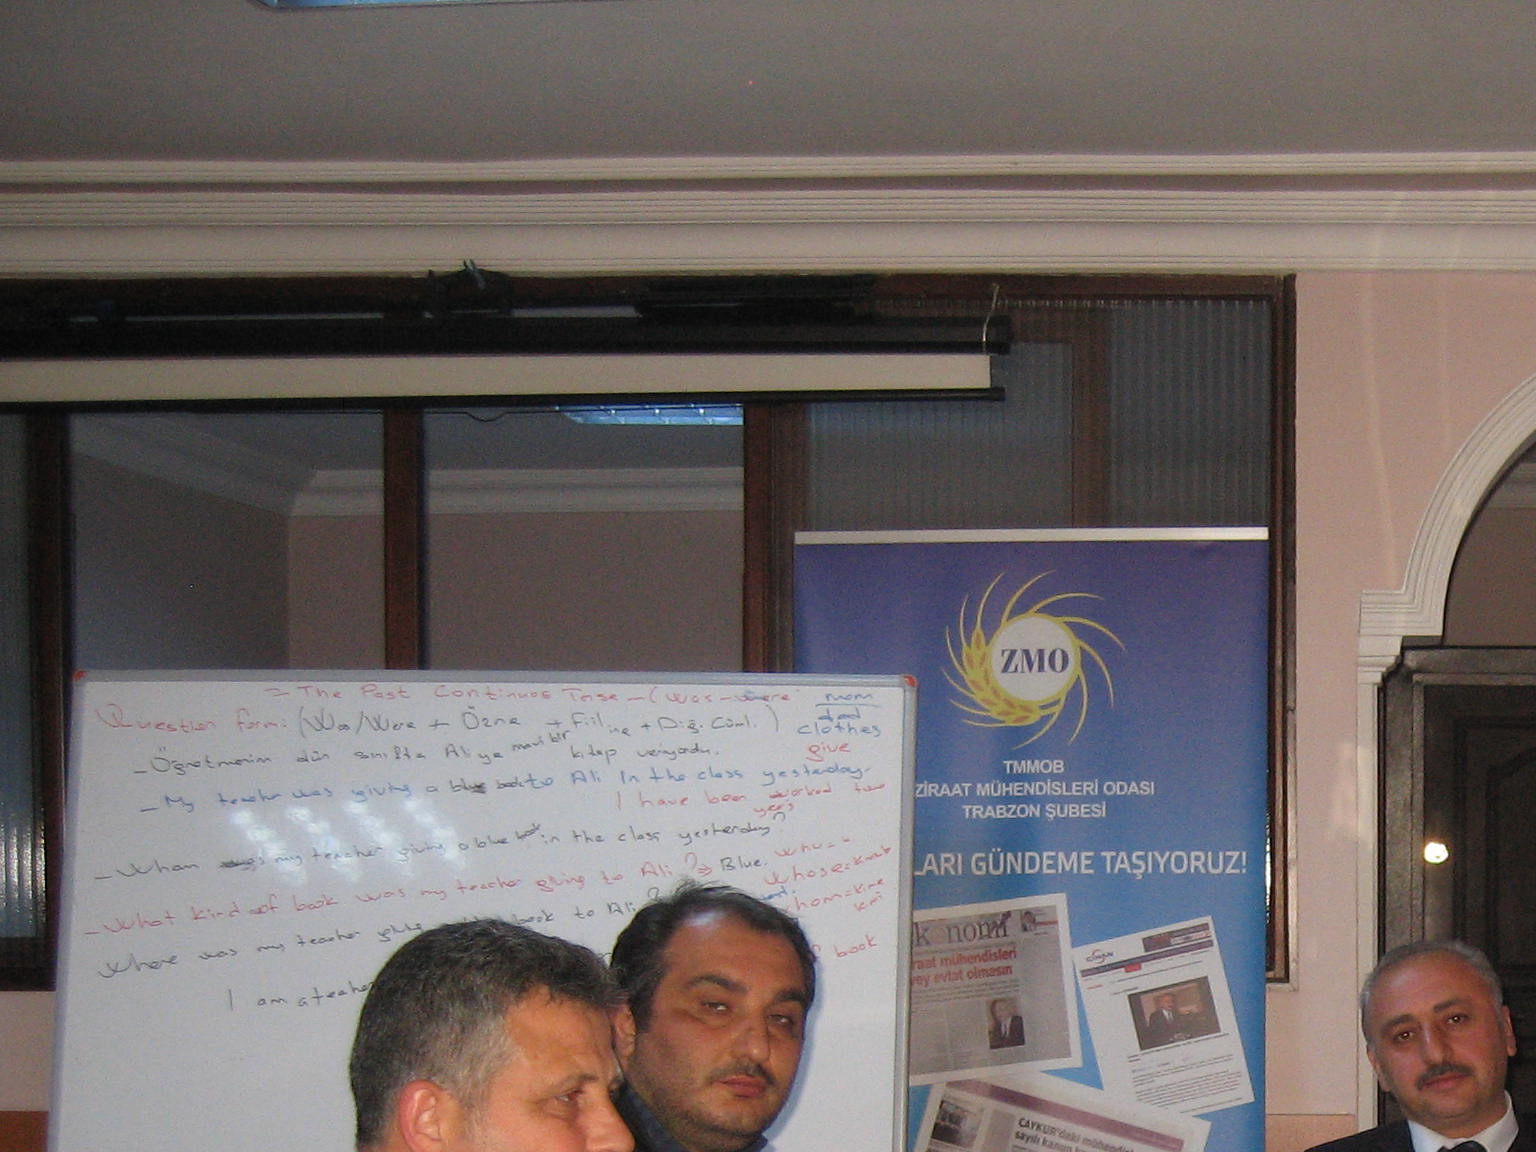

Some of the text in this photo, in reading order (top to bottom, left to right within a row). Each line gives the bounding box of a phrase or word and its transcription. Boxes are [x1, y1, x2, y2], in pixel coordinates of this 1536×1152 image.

[1000, 648, 1070, 674] ZMO
[361, 684, 410, 700] Past
[797, 721, 881, 737] clothes
[805, 742, 851, 763] give
[570, 770, 602, 785] Ali
[650, 767, 687, 782] the
[1003, 760, 1064, 775] TMMOB
[915, 779, 1155, 798] ZİRAAT MÜHENDİSLERİ ODASI
[639, 792, 688, 807] have
[962, 803, 1107, 821] TRABZON ŞUBESİ
[572, 830, 605, 843] the
[914, 847, 1247, 881] ARI GÜNDEME TAŞIYORUZ!
